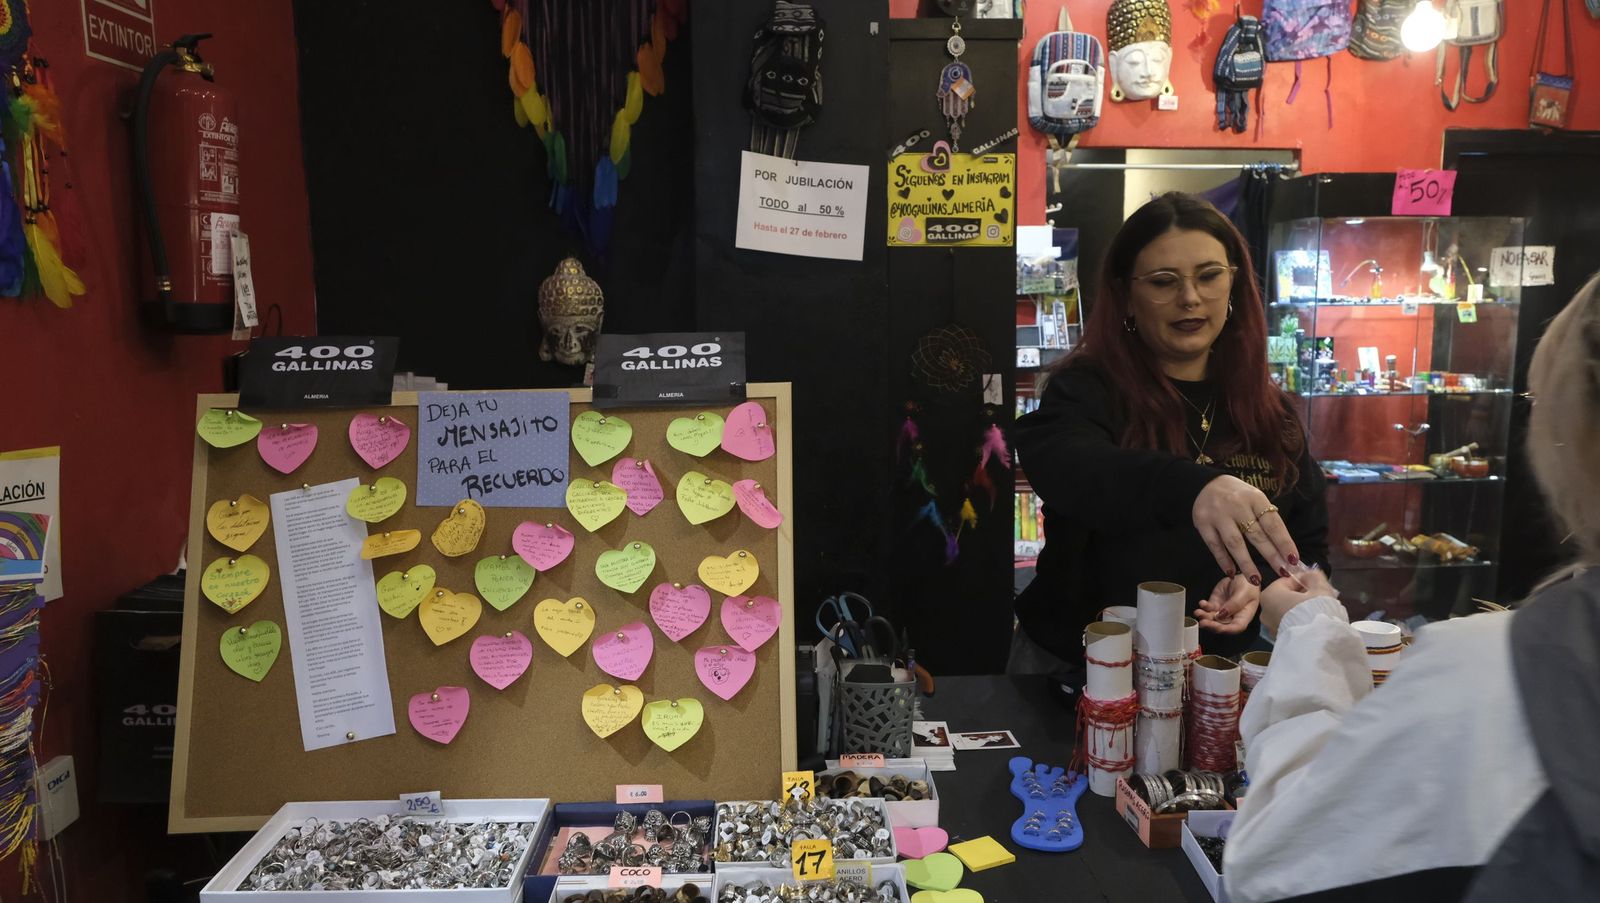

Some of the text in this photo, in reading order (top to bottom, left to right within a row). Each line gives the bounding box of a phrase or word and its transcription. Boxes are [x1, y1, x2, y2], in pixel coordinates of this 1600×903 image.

[89, 14, 154, 58] EXTINTOR
[892, 130, 930, 156] 400
[973, 128, 1018, 155] GALLINAS
[754, 169, 854, 190] POR JUBILACIÓN
[952, 174, 968, 186] EN
[759, 196, 845, 216] TODO al 50 %
[754, 221, 848, 240] Hasta el 27 de febrero
[927, 224, 979, 233] 400
[1500, 250, 1516, 267] NO
[274, 345, 375, 359] 400
[622, 342, 722, 359] 400
[271, 360, 374, 372] GALLINAS
[621, 356, 723, 371] GALLINAS
[427, 399, 498, 423] DEJA TU
[427, 449, 499, 475] PARA EL
[0, 480, 45, 504] ACIÓN
[461, 468, 565, 499] RECUERDO
[48, 770, 71, 791] DIGI
[620, 868, 651, 876] COCO
[795, 850, 828, 876] 17
[836, 867, 867, 875] ANILLOS
